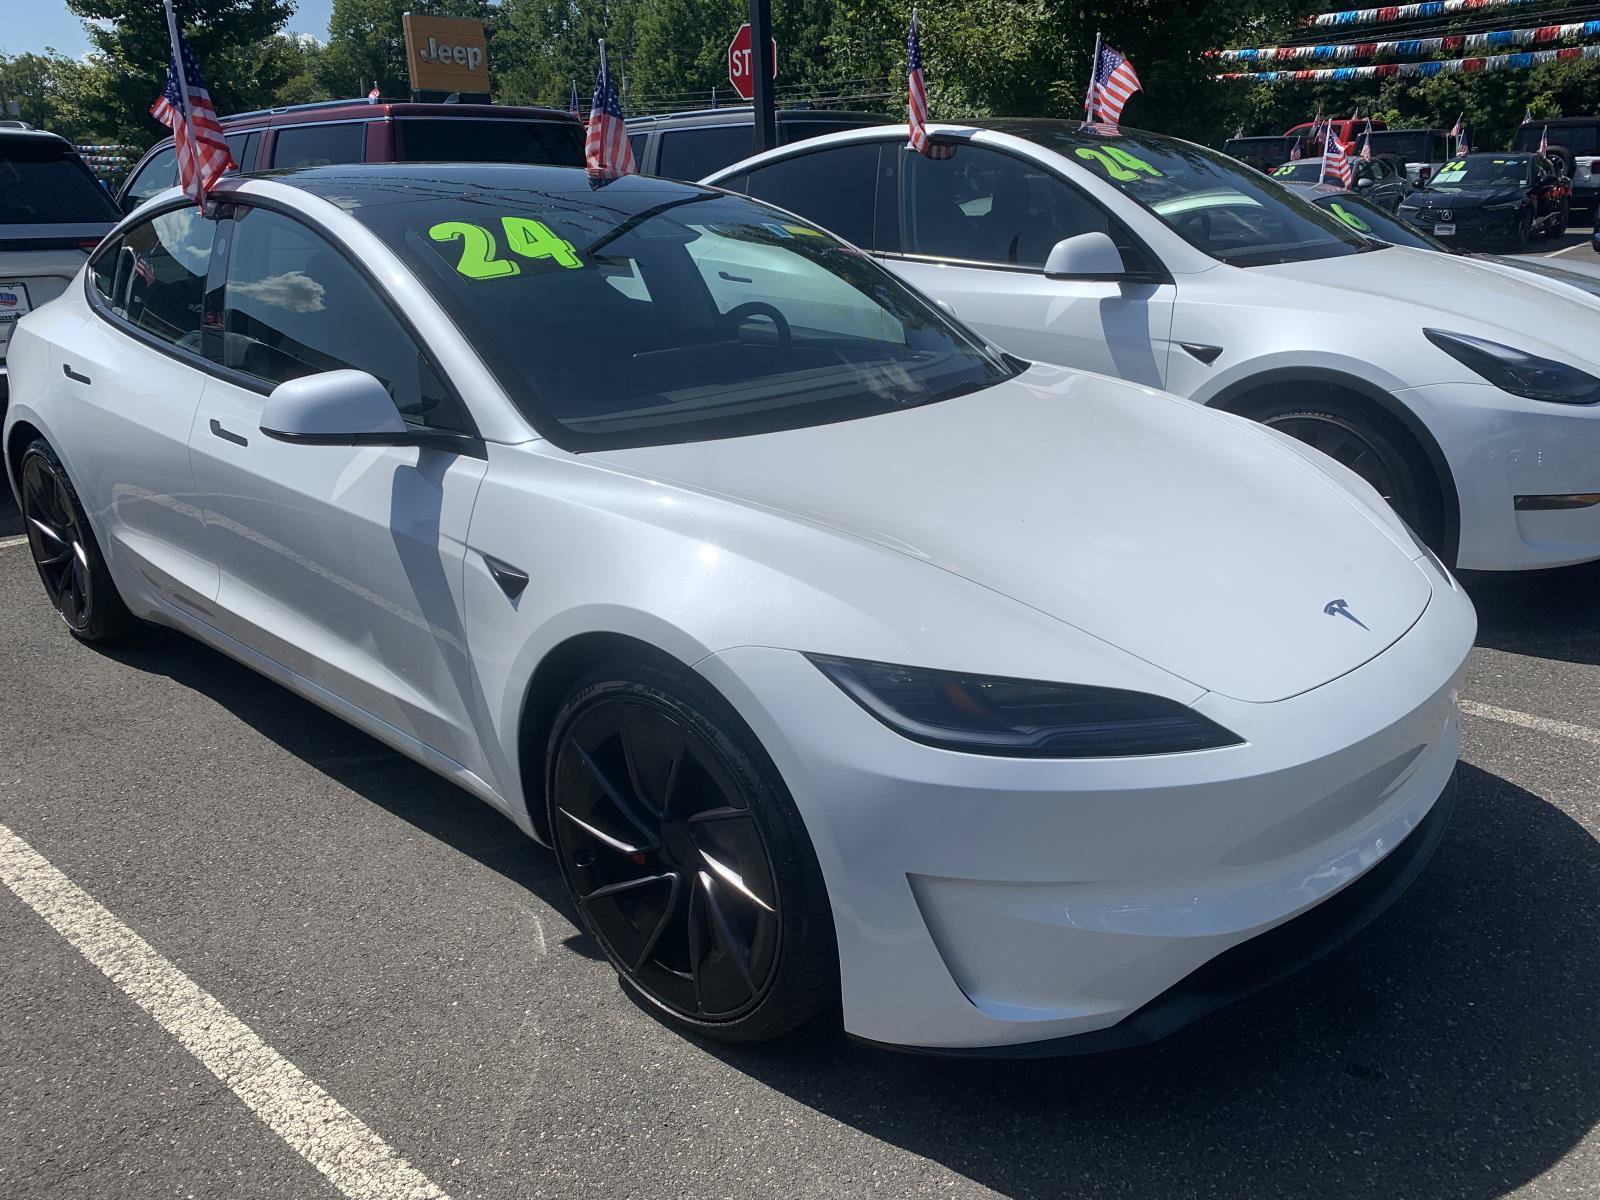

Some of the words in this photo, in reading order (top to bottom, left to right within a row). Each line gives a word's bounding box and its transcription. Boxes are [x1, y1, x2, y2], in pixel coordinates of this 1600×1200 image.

[420, 36, 482, 71] Jeep
[732, 49, 752, 77] ST
[1074, 145, 1163, 181] 24
[428, 216, 584, 279] 24
